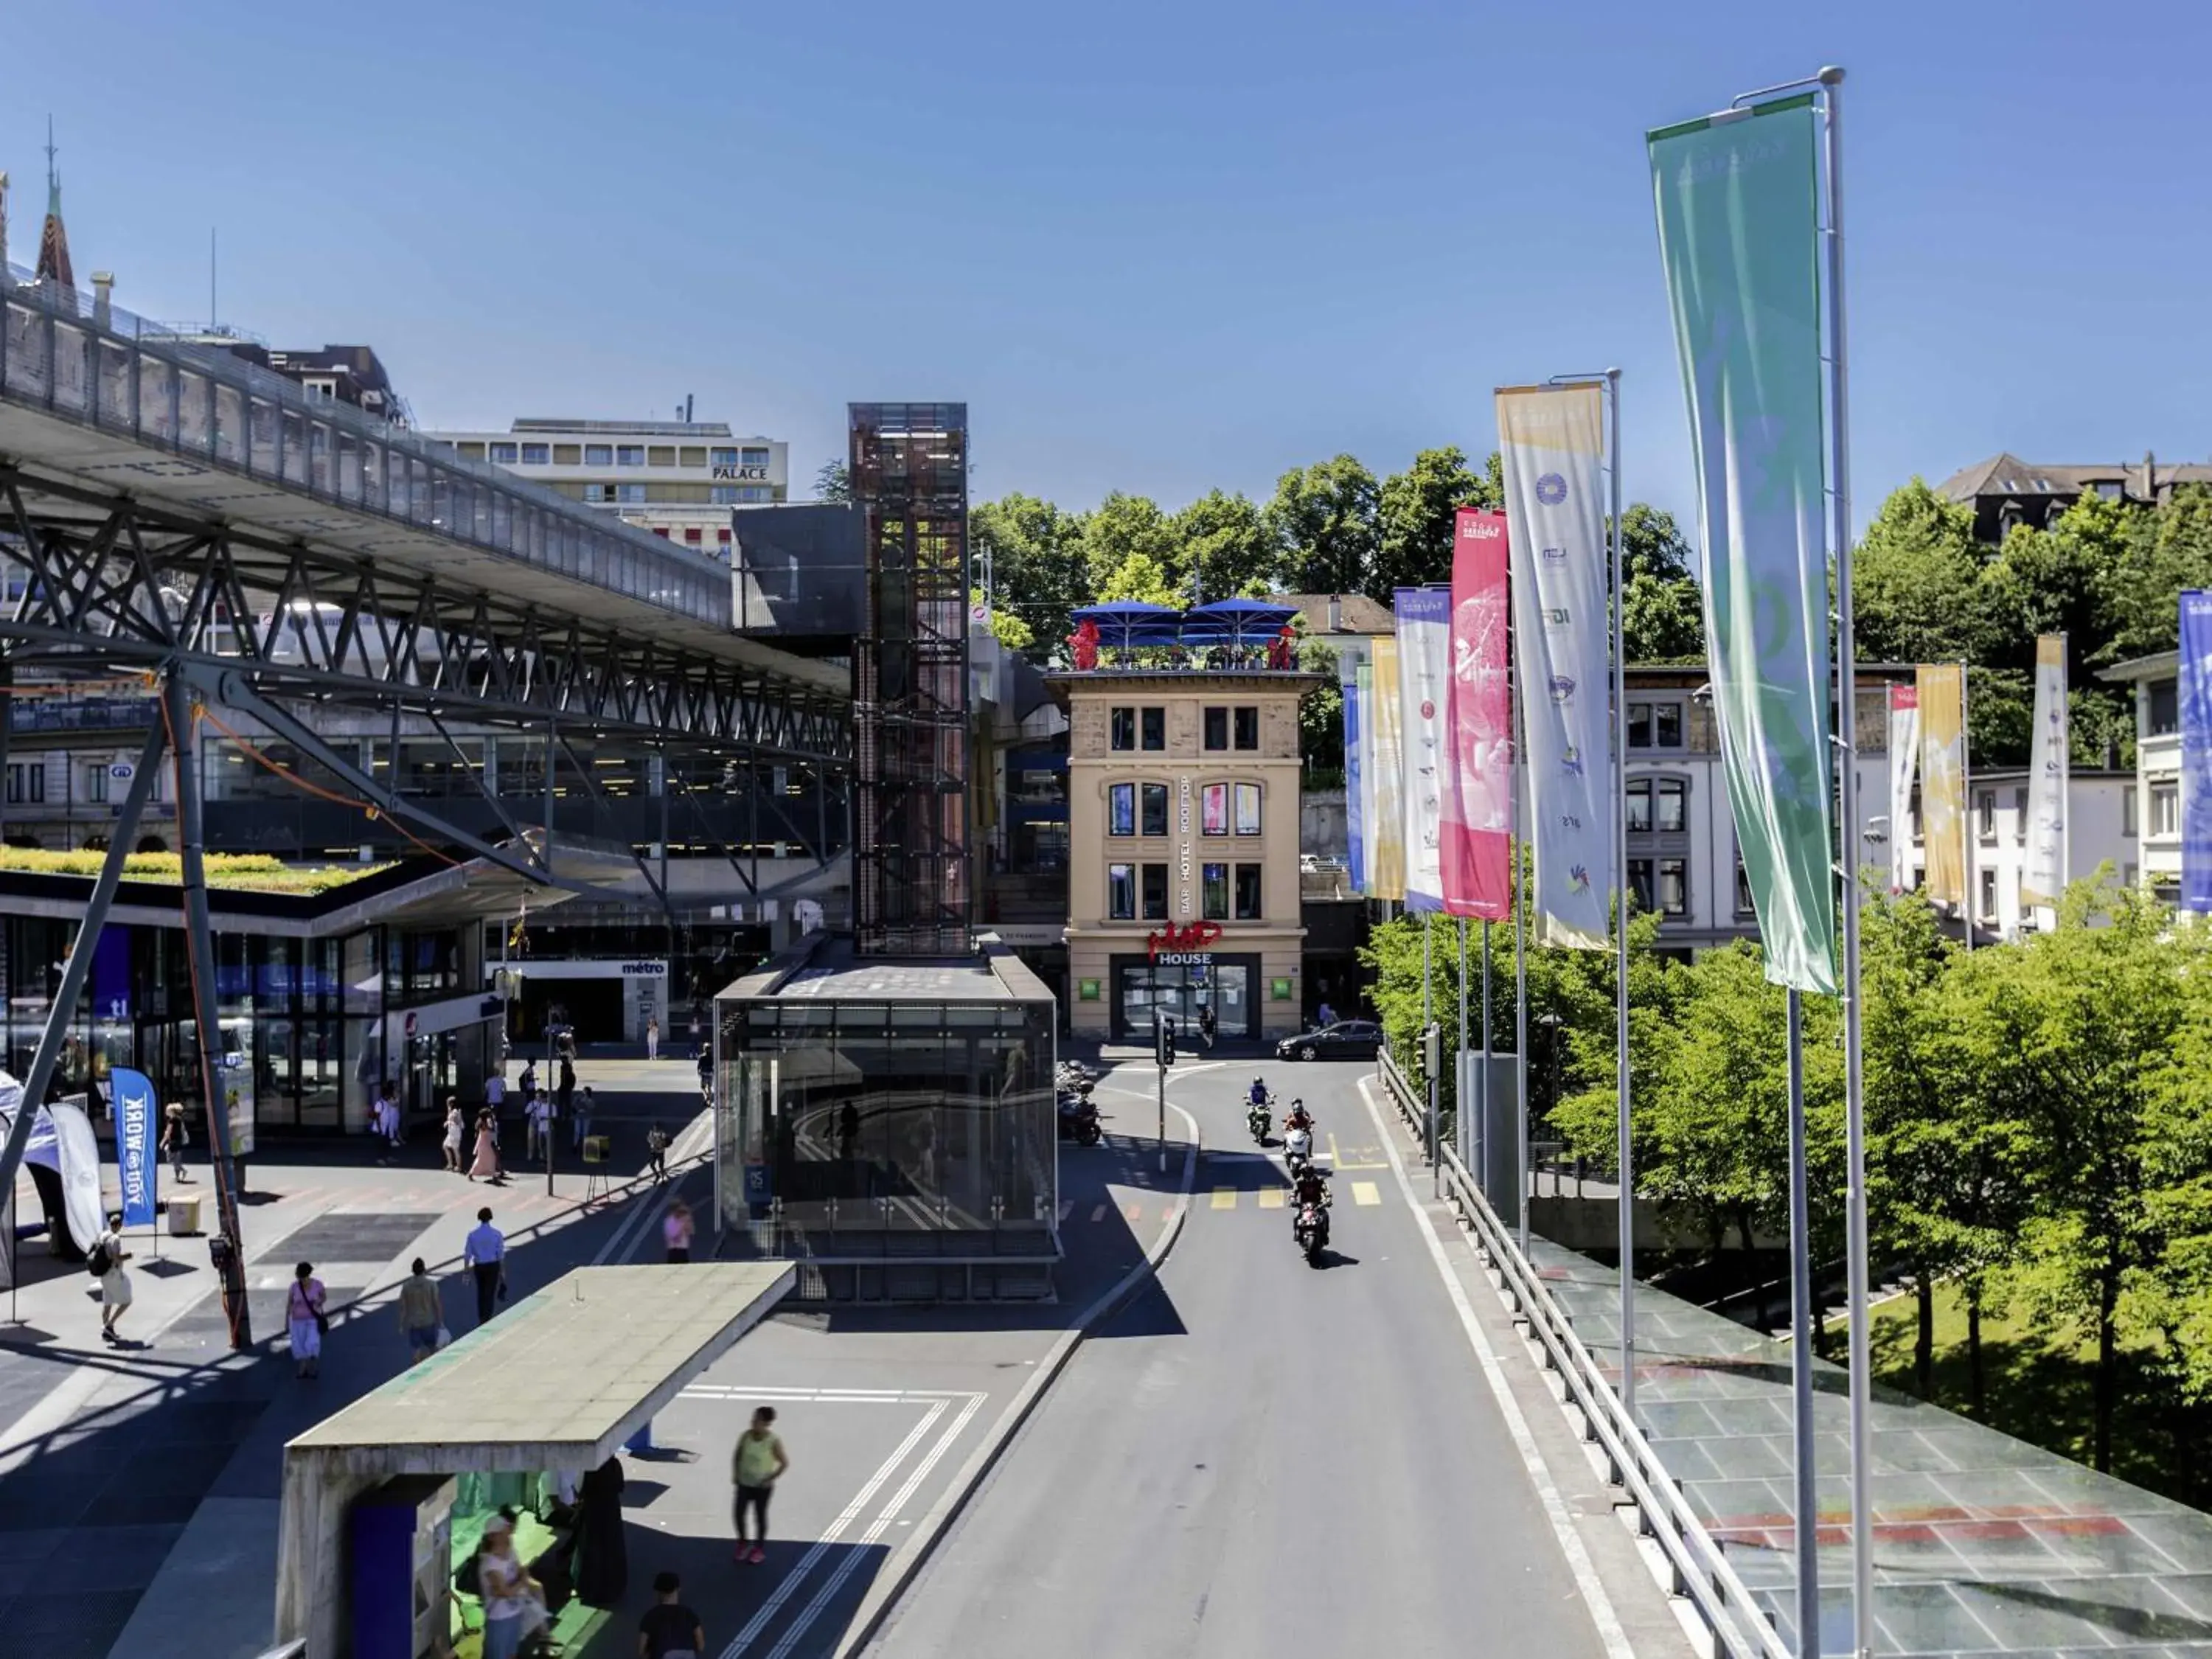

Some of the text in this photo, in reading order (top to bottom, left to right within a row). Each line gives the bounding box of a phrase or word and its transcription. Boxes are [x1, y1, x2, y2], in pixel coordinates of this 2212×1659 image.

[713, 467, 767, 479] PALACE
[1181, 776, 1190, 914] BAR HOTEL ROOFTOP
[1160, 953, 1211, 964] HOUSE
[622, 961, 664, 974] métro
[111, 998, 127, 1017] tl
